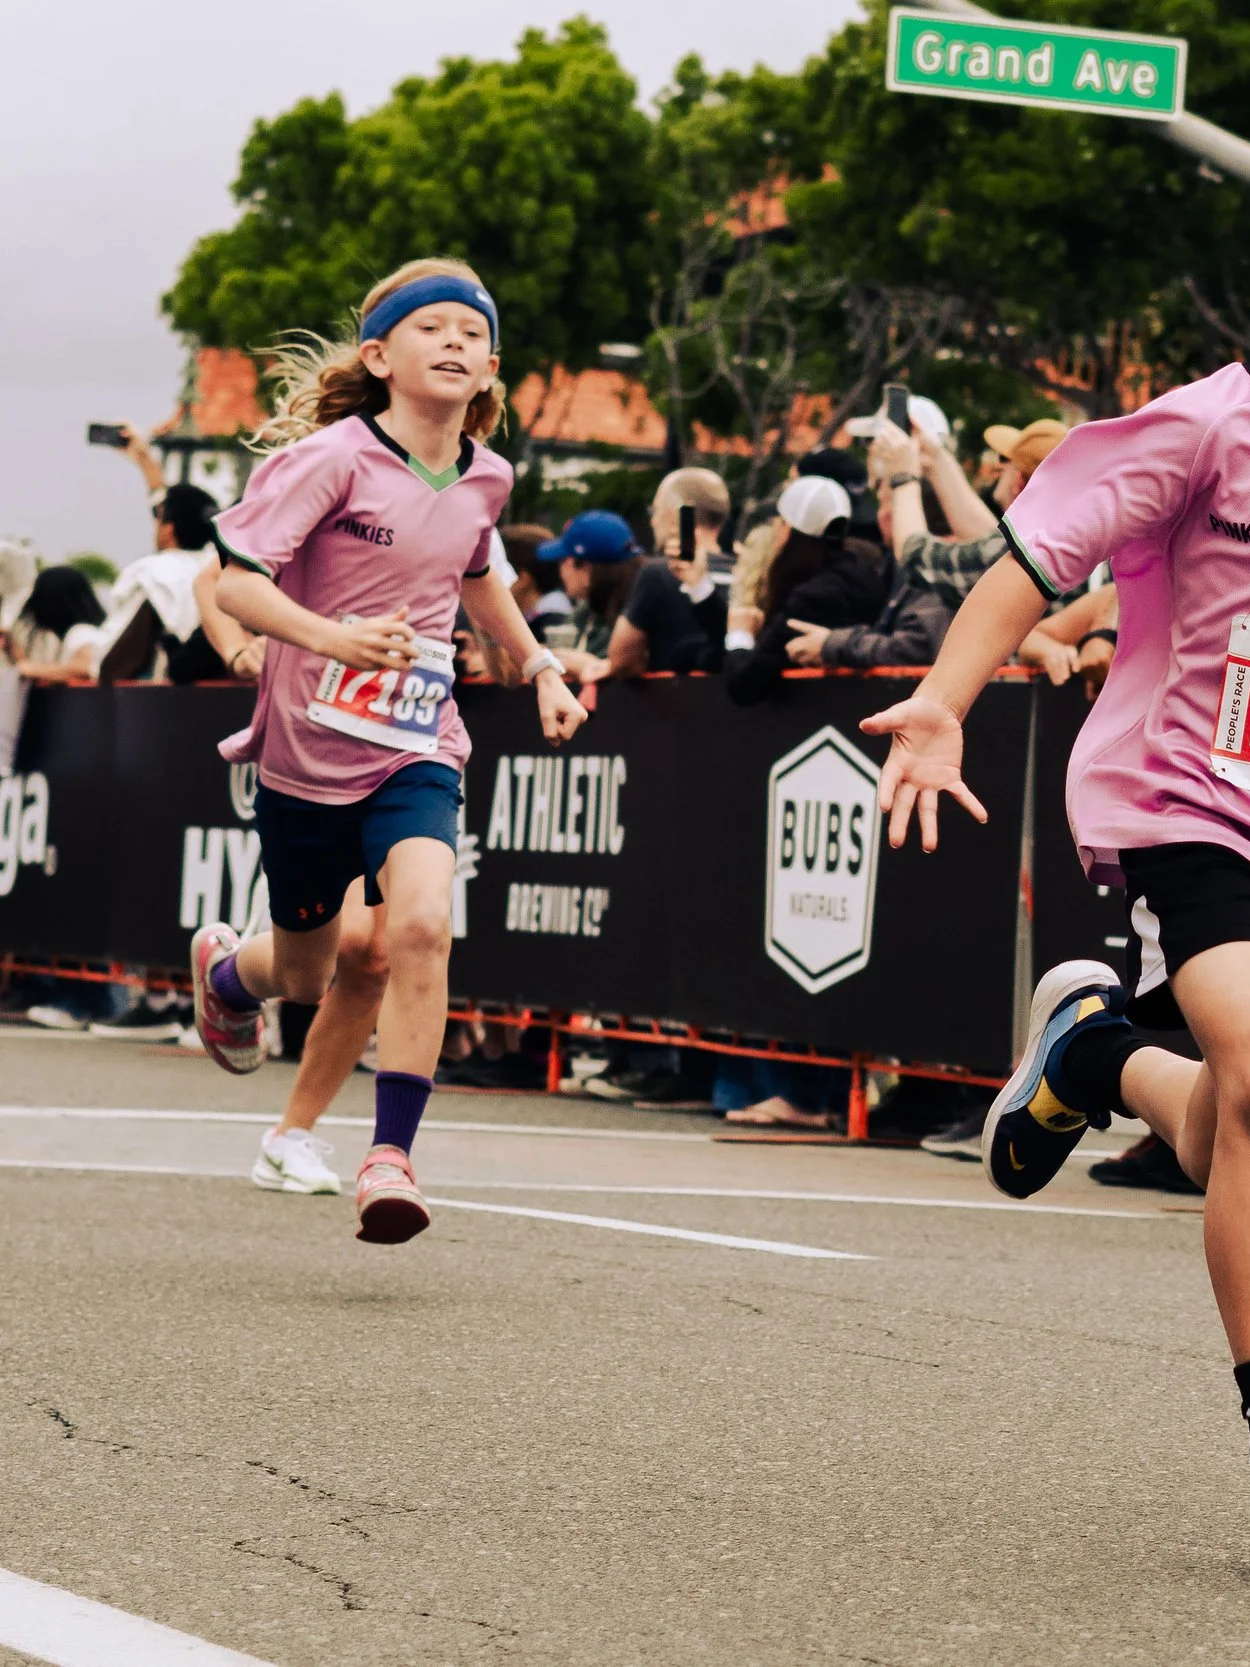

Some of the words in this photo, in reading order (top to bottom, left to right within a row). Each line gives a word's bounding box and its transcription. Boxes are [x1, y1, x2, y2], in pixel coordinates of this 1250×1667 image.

[914, 31, 1054, 85] Grand
[1074, 49, 1157, 97] Ave
[335, 518, 394, 547] PINKIES
[1225, 698, 1241, 751] PEOPLE'S
[1234, 666, 1247, 697] RACE
[486, 755, 628, 855] ATHLETIC
[780, 799, 865, 877] BUBS
